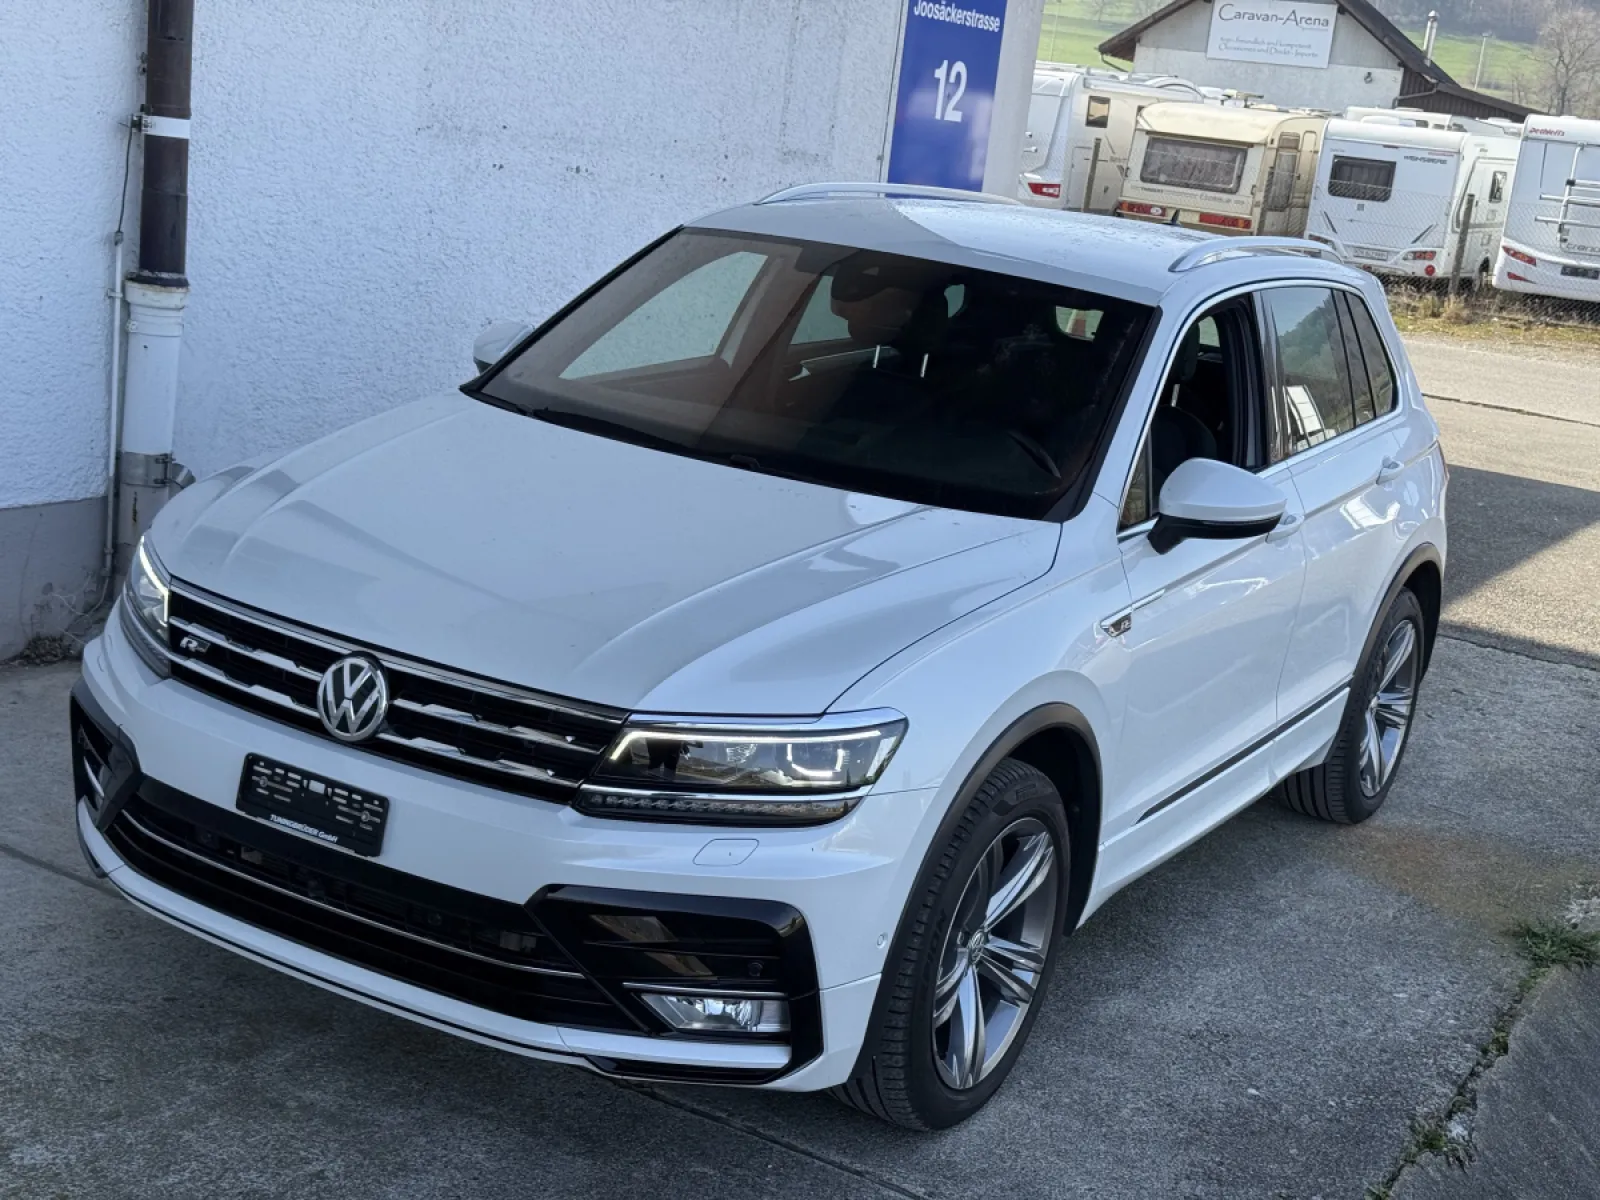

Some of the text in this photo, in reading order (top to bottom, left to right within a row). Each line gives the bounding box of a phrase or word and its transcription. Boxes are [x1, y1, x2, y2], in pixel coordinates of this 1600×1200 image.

[913, 0, 1000, 32] Joosäckerstrasse
[1218, 3, 1329, 27] Caravan-Arena
[934, 60, 968, 122] 12
[318, 655, 388, 741] VW
[319, 831, 339, 843] GmbH
